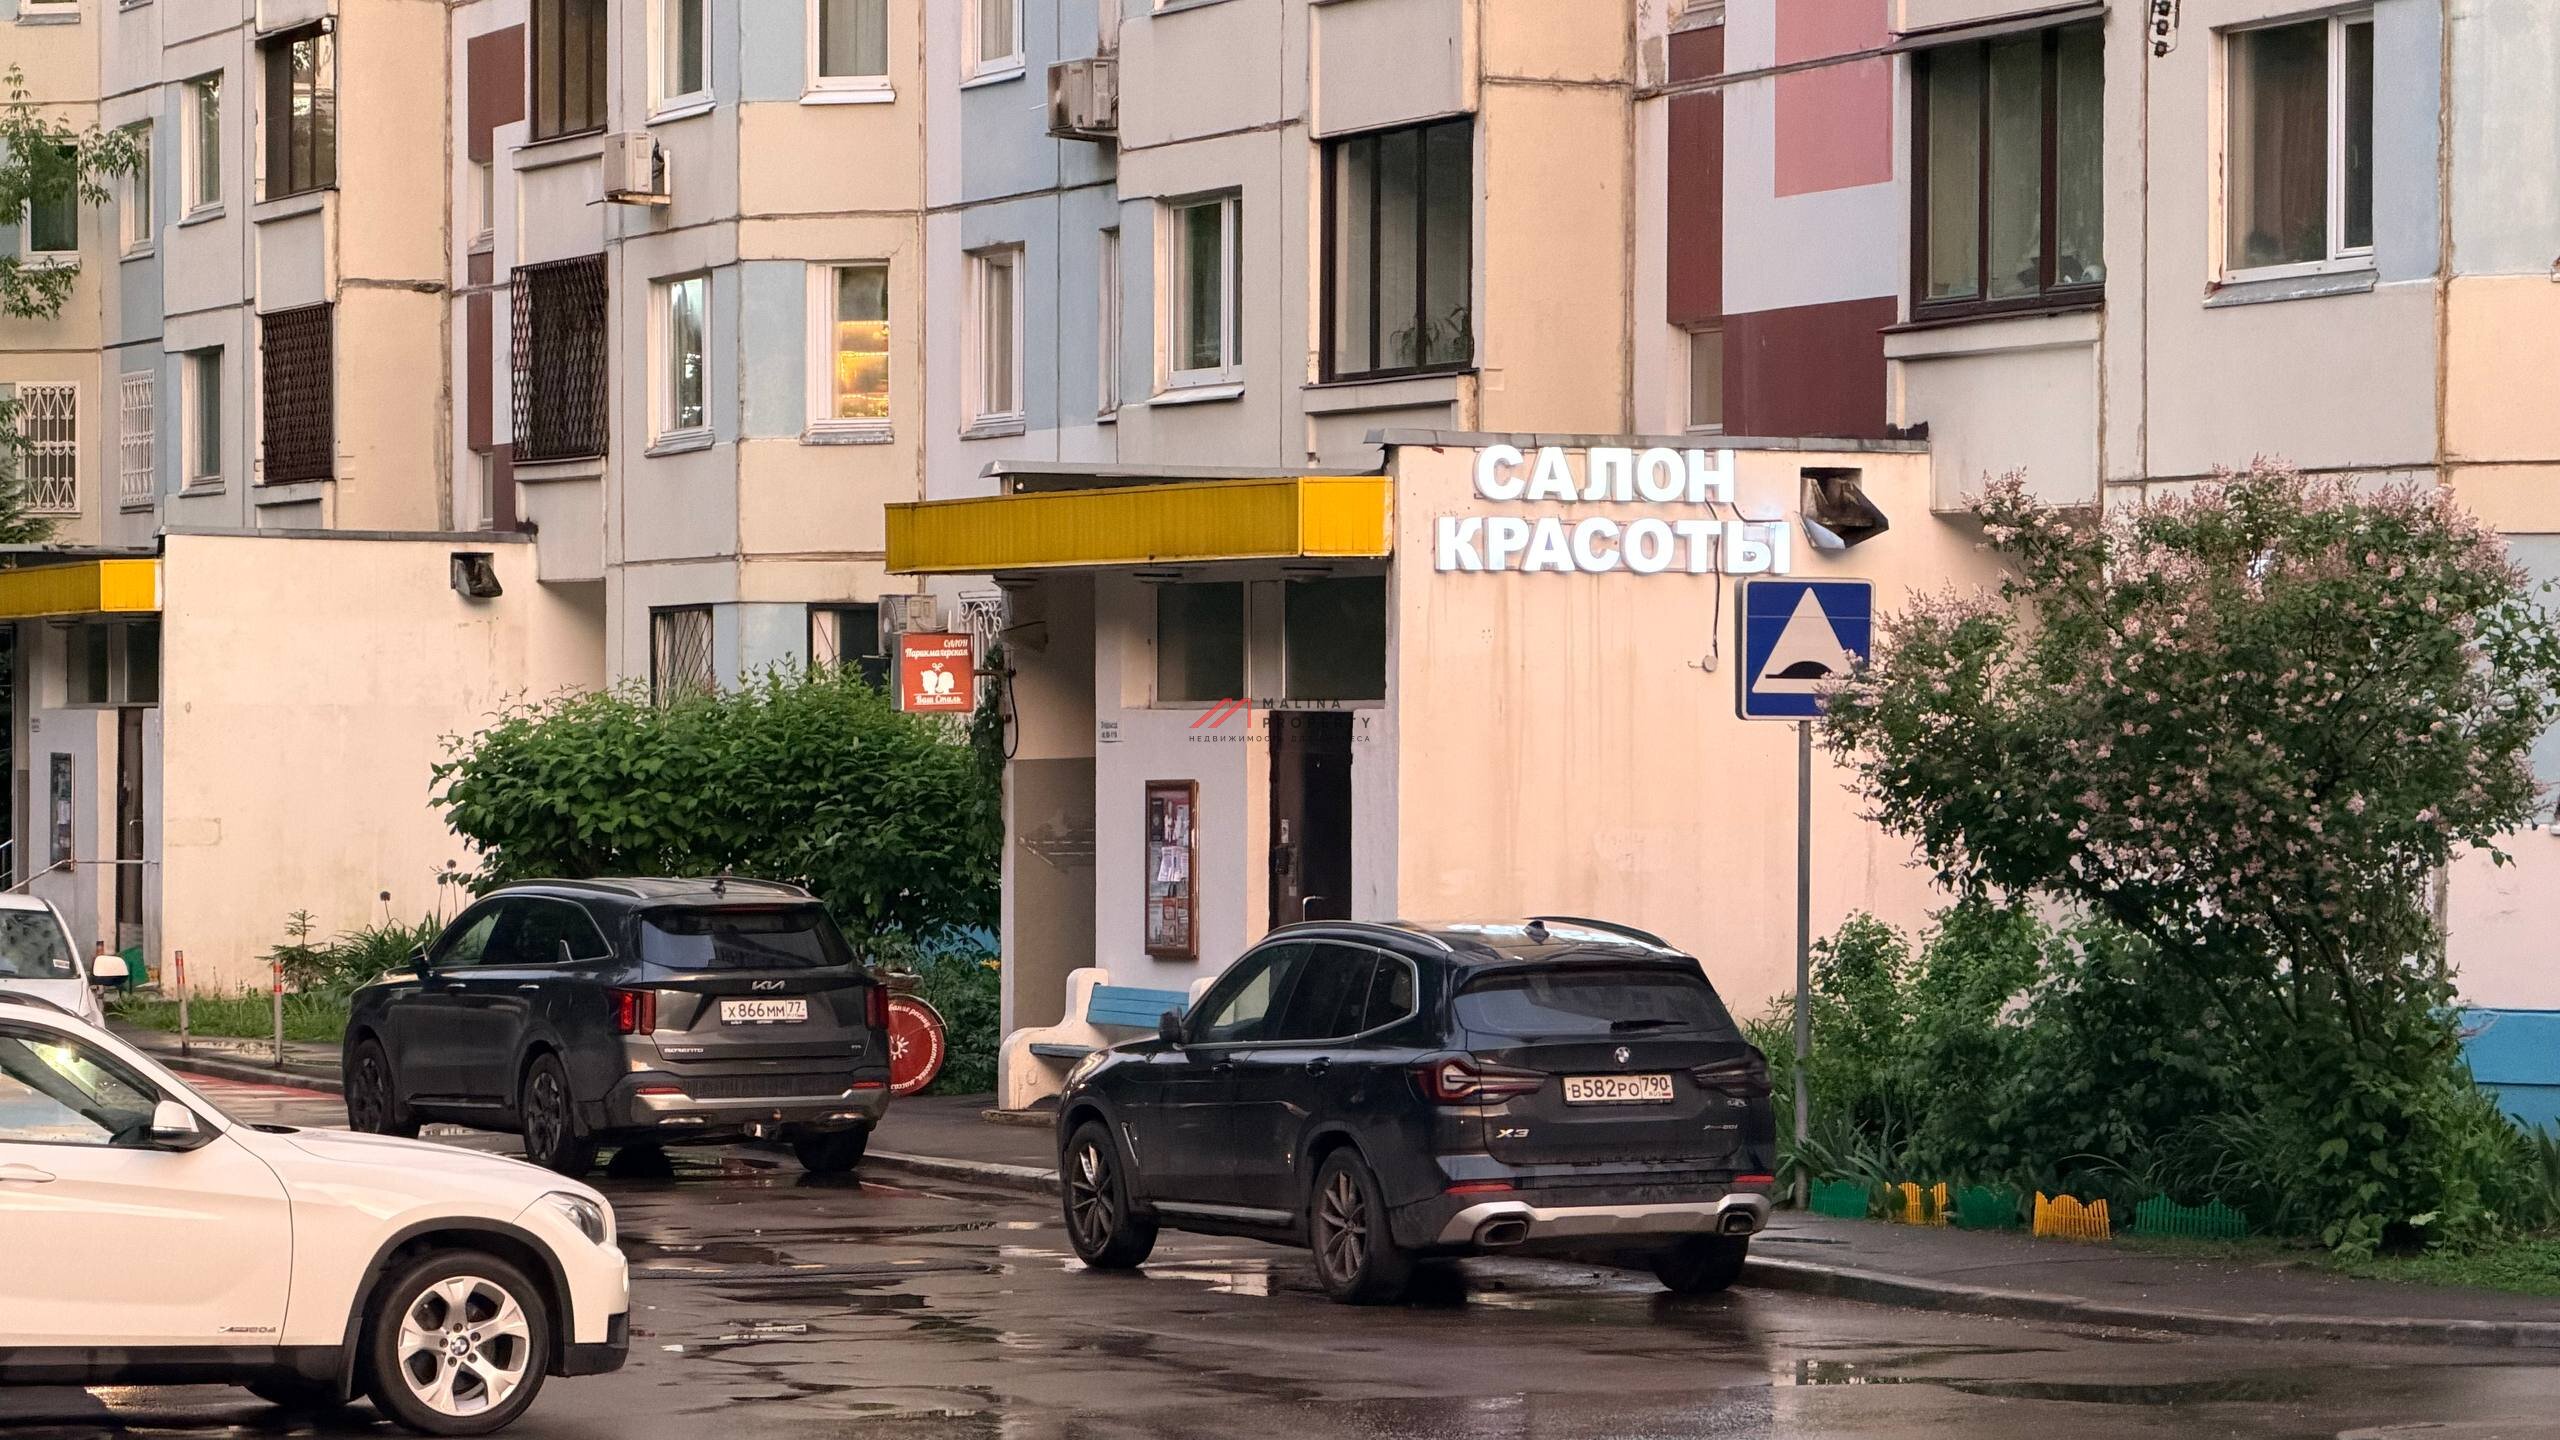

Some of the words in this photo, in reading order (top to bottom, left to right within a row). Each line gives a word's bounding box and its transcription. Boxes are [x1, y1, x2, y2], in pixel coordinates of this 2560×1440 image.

[1473, 444, 1735, 502] САЛОН
[1435, 515, 1791, 574] КРАСОТЫ
[935, 695, 961, 704] Стиль
[728, 1003, 785, 1018] Х866ММ
[788, 1001, 801, 1013] 77
[1571, 1079, 1640, 1098] В582РО
[1641, 1077, 1668, 1092] 790
[1496, 1129, 1529, 1138] X3
